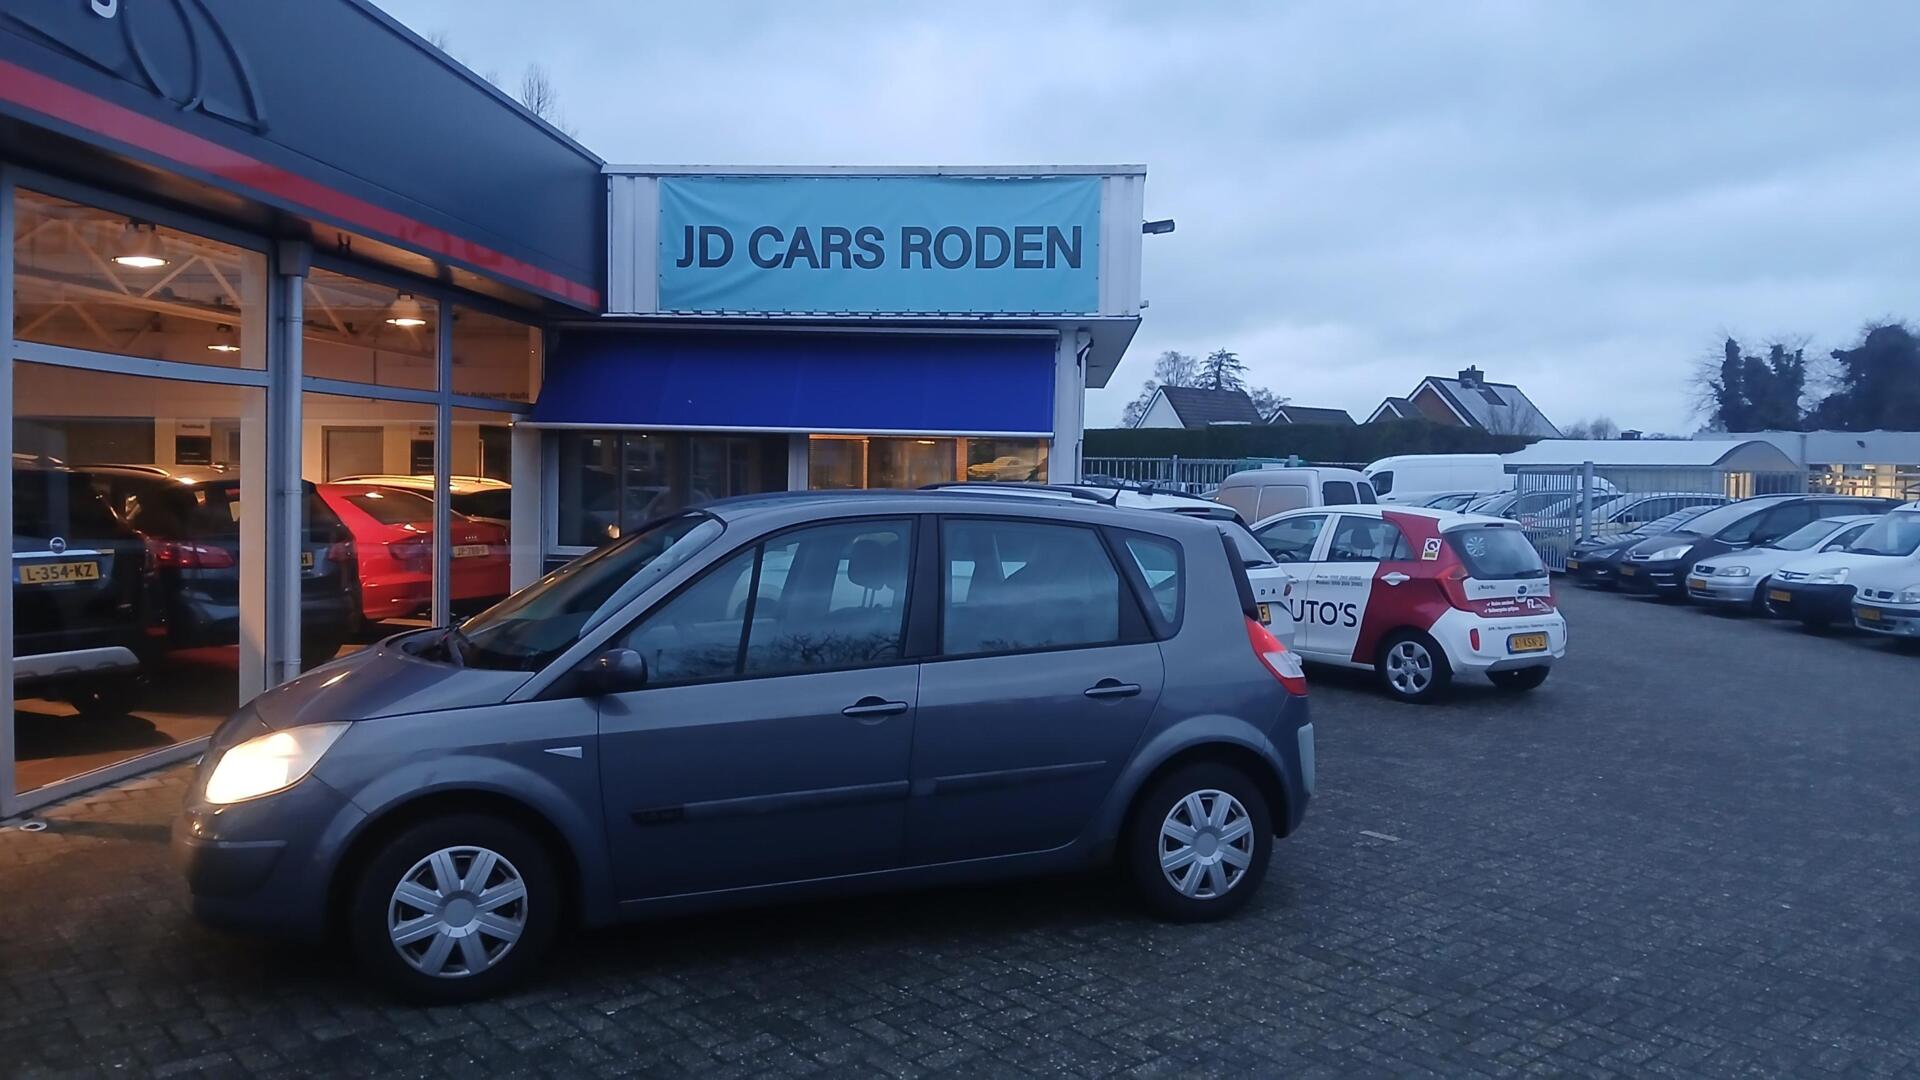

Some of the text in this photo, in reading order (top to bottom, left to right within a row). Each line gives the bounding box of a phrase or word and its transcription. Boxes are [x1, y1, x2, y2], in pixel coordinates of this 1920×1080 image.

[676, 225, 1082, 270] JD CARS RODEN
[26, 564, 93, 581] L-354-KZ
[1289, 598, 1358, 628] UTO'S
